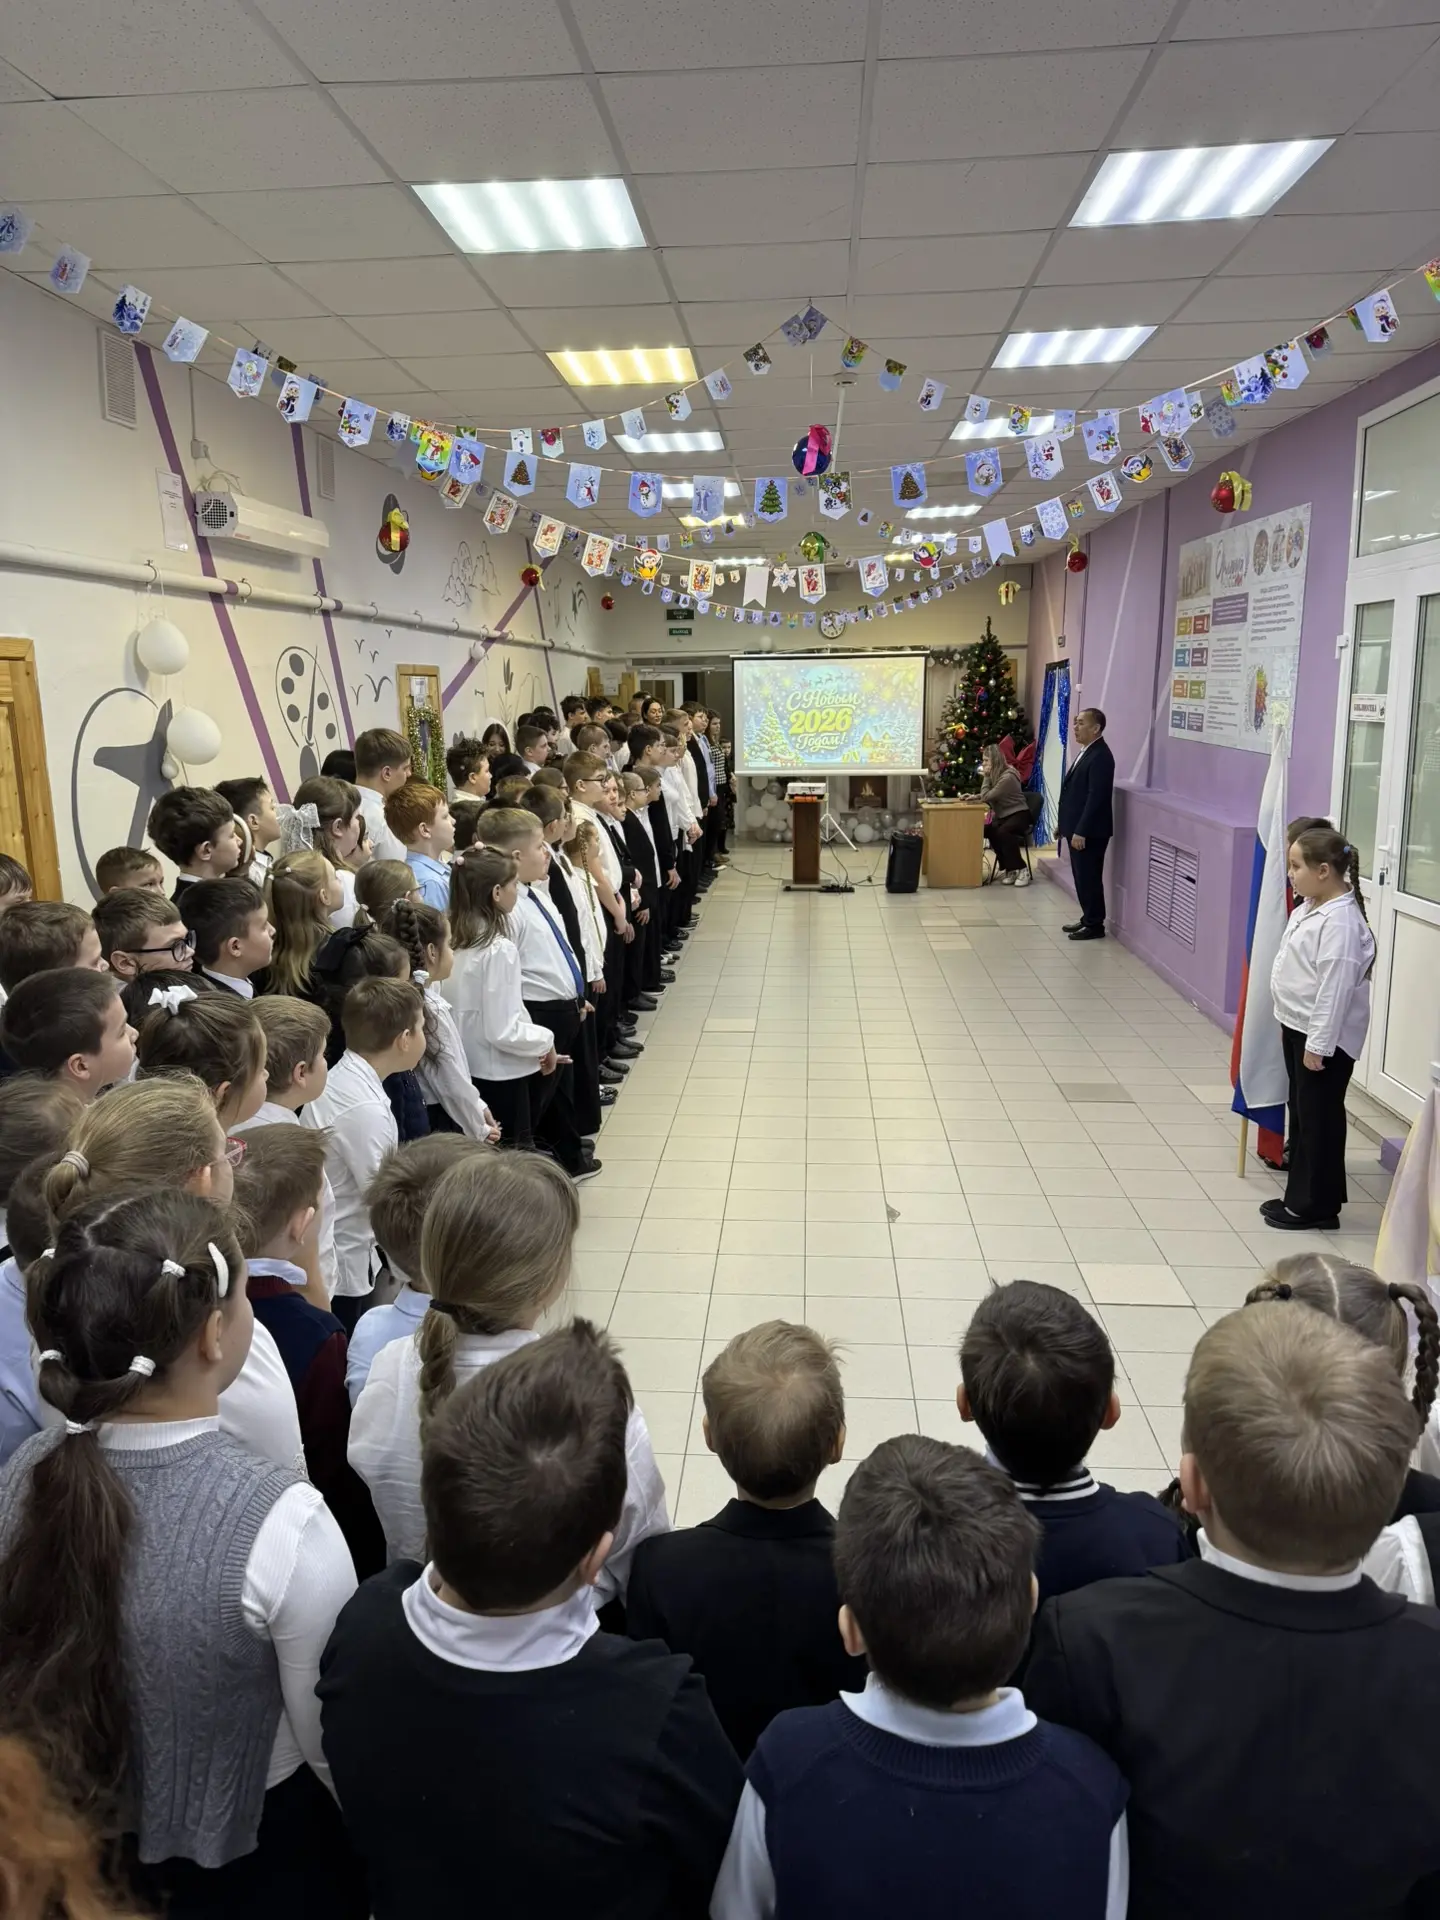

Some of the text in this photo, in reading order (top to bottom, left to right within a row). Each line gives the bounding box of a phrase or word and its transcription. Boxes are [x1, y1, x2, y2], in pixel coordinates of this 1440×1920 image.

[786, 689, 861, 711] С Новым
[789, 708, 853, 735] 2026
[796, 732, 848, 752] Годом!
